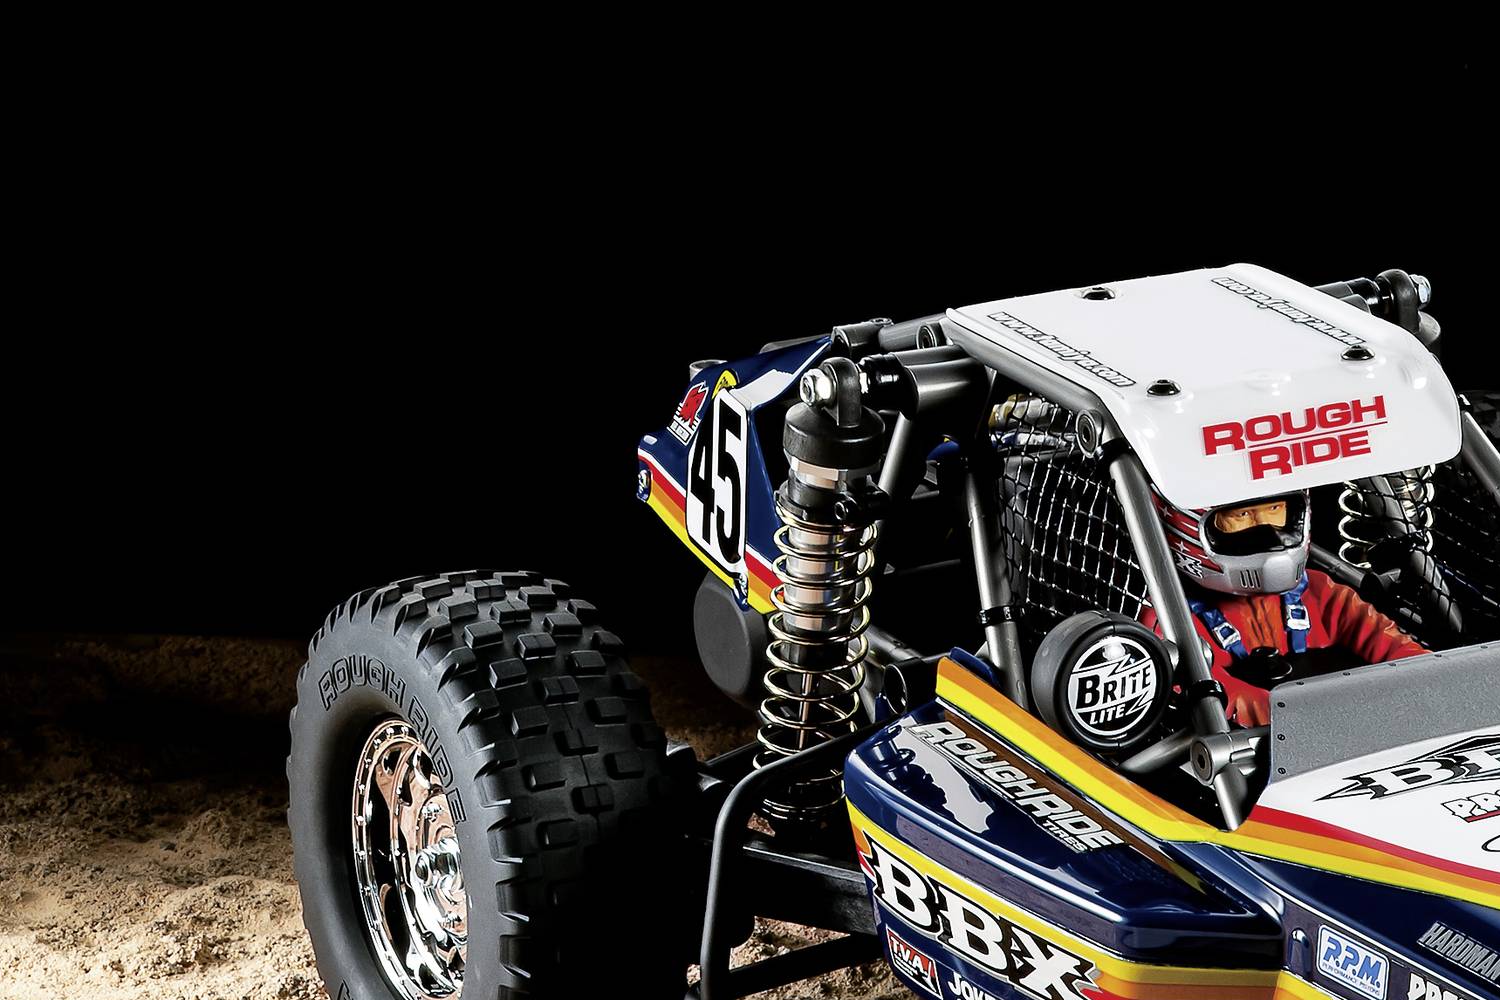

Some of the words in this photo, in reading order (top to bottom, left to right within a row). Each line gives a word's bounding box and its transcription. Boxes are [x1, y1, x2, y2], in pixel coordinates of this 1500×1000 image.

[1202, 395, 1387, 456] ROUGH
[1250, 430, 1371, 480] RIDE
[690, 397, 742, 565] 45
[1075, 664, 1152, 710] BRITE
[318, 655, 406, 711] ROUGH
[408, 696, 467, 824] RIDE
[1089, 703, 1126, 725] LITE
[1041, 819, 1088, 854] TIRES
[1322, 936, 1381, 989] R.P.M.
